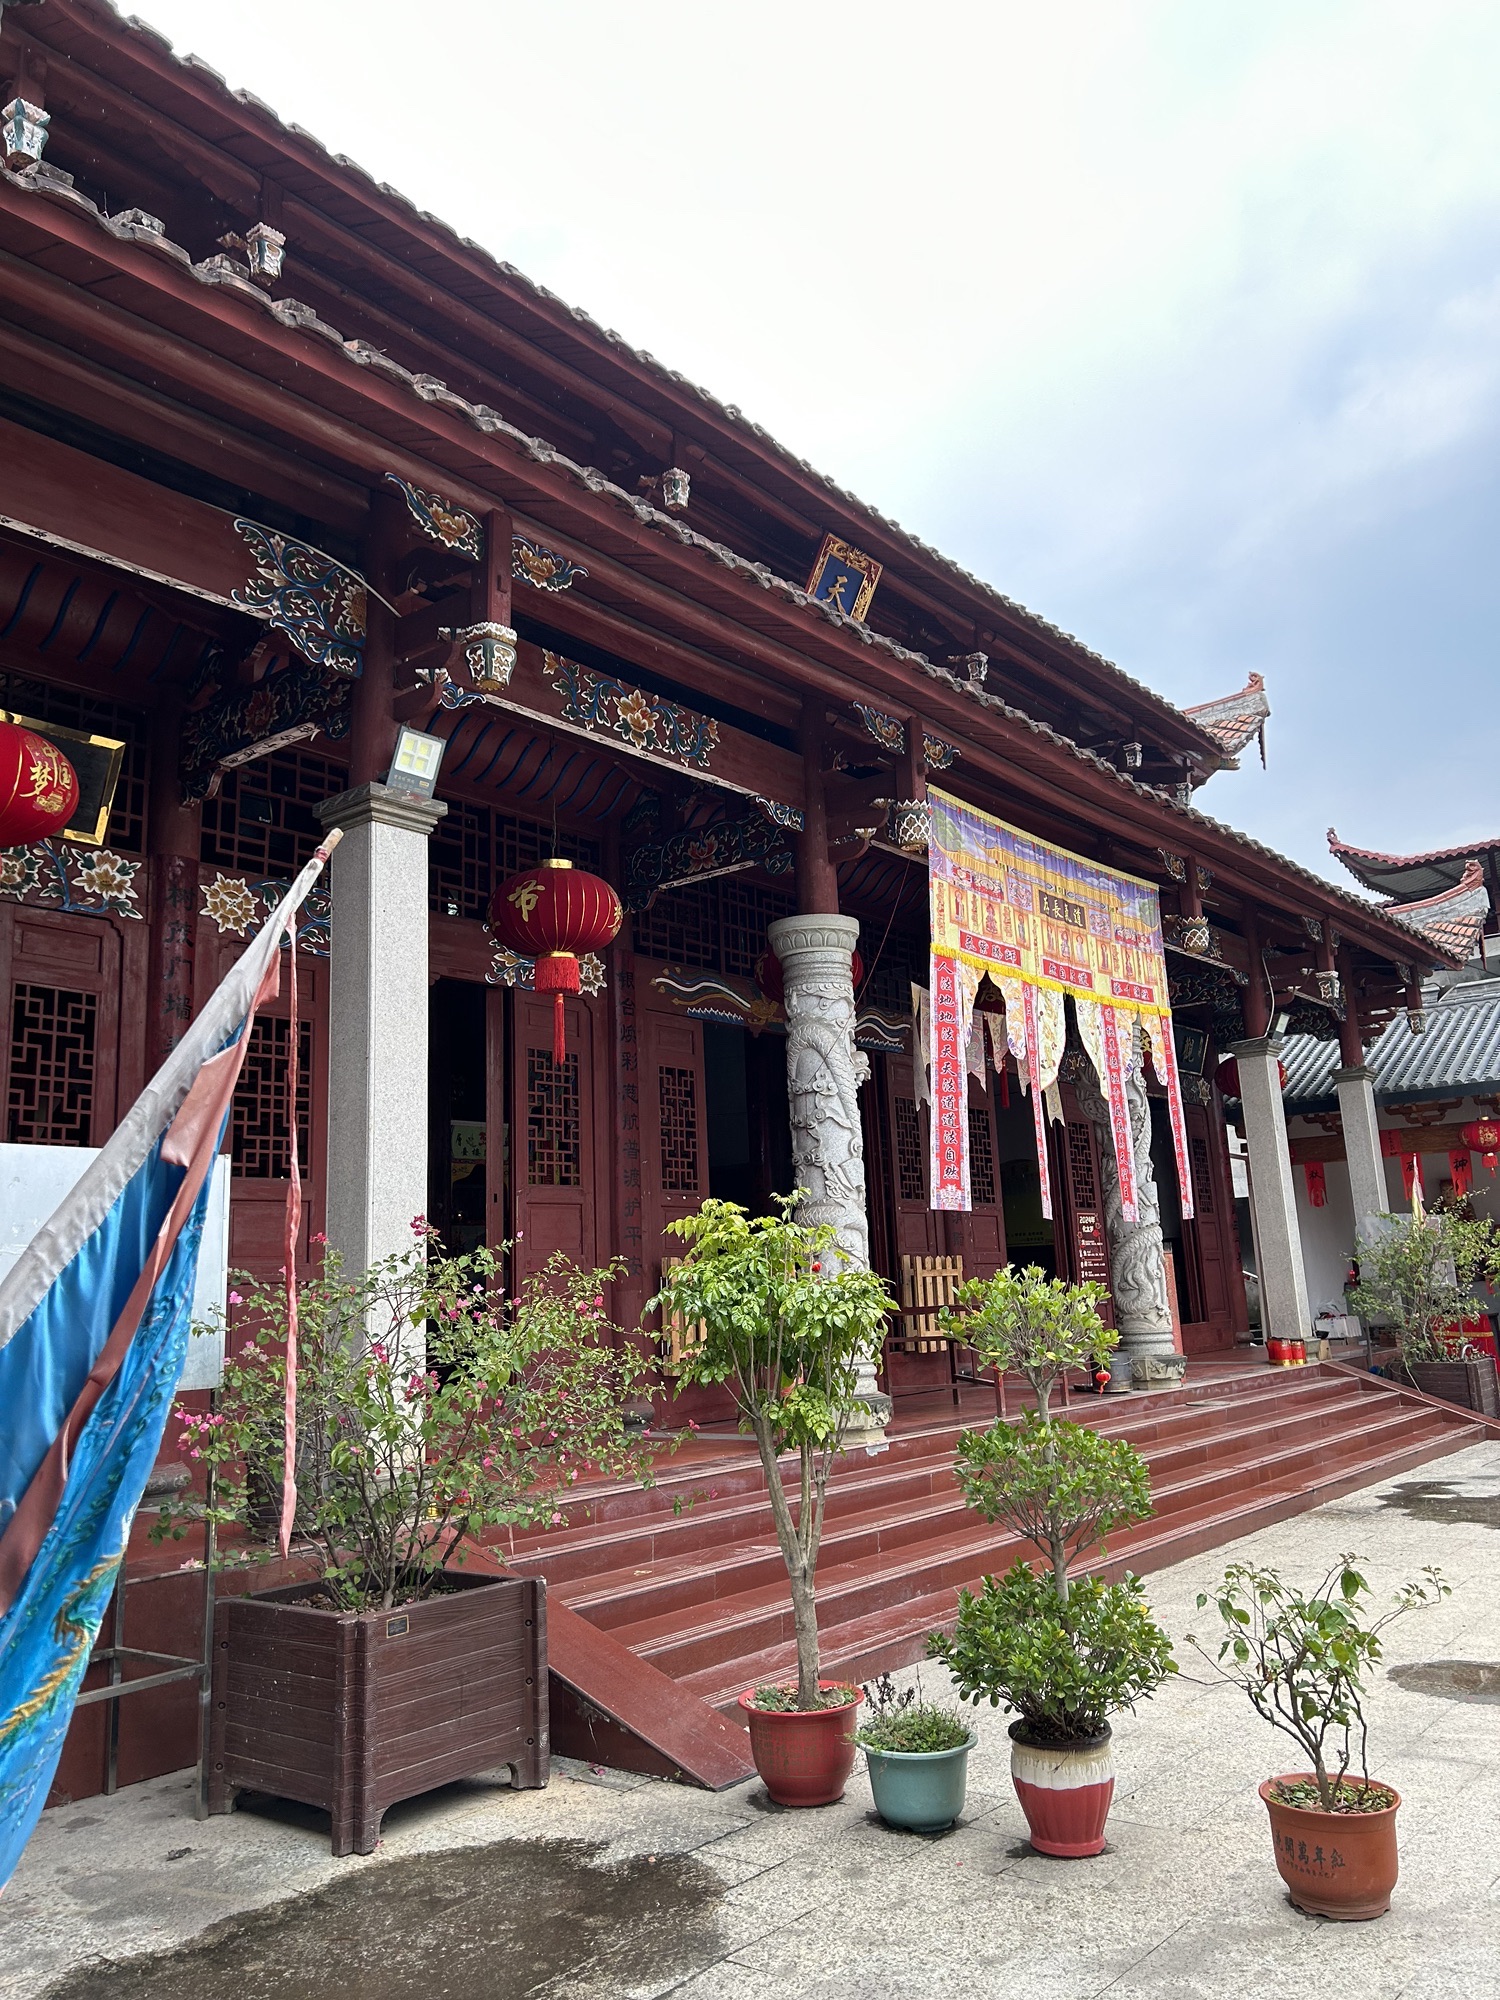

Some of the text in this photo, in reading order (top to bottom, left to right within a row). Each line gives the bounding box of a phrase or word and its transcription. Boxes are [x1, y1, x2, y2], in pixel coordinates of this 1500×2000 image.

[822, 575, 848, 615] 天
[506, 880, 546, 923] 节
[937, 961, 959, 1182] 人法地地法天天法道道法自然
